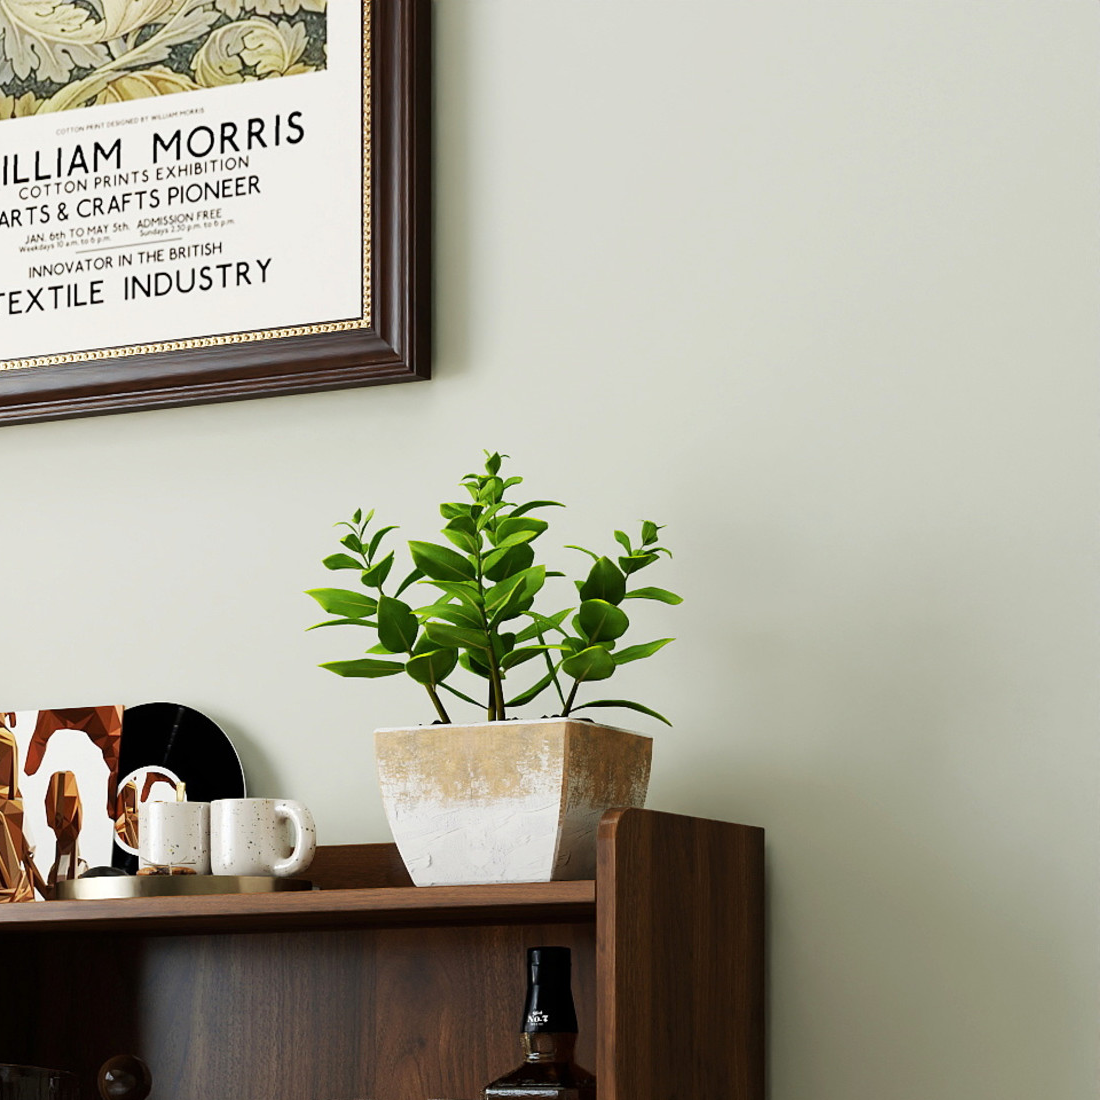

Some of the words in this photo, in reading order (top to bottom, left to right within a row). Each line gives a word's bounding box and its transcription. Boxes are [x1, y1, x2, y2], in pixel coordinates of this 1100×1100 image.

[56, 126, 84, 136] COTTON
[86, 122, 104, 131] PRINT
[106, 117, 139, 129] DESIGNED
[140, 115, 148, 123] BY
[151, 111, 178, 121] WILLIAM
[179, 106, 204, 117] MORRIS
[153, 110, 304, 164] MORRIS
[19, 178, 87, 201] COTTON
[95, 169, 149, 190] PRINTS
[156, 155, 249, 181] EXHIBITION
[57, 201, 69, 222] &
[77, 188, 160, 218] CRAFTS
[168, 174, 260, 206] PIONEER
[49, 230, 66, 242] 6th
[69, 227, 85, 238] TO
[87, 224, 109, 236] MAY
[137, 212, 194, 229] ADMISSION
[197, 208, 222, 221] FREE
[140, 227, 169, 237] Sundays
[204, 221, 212, 229] to
[19, 243, 54, 253] Weekdays
[57, 240, 64, 249] 10
[81, 238, 89, 246] to
[29, 256, 113, 279] INNOVATOR
[119, 254, 132, 267] IN
[137, 248, 164, 264] THE
[169, 241, 222, 261] BRITISH
[125, 258, 271, 300] INDUSTRY
